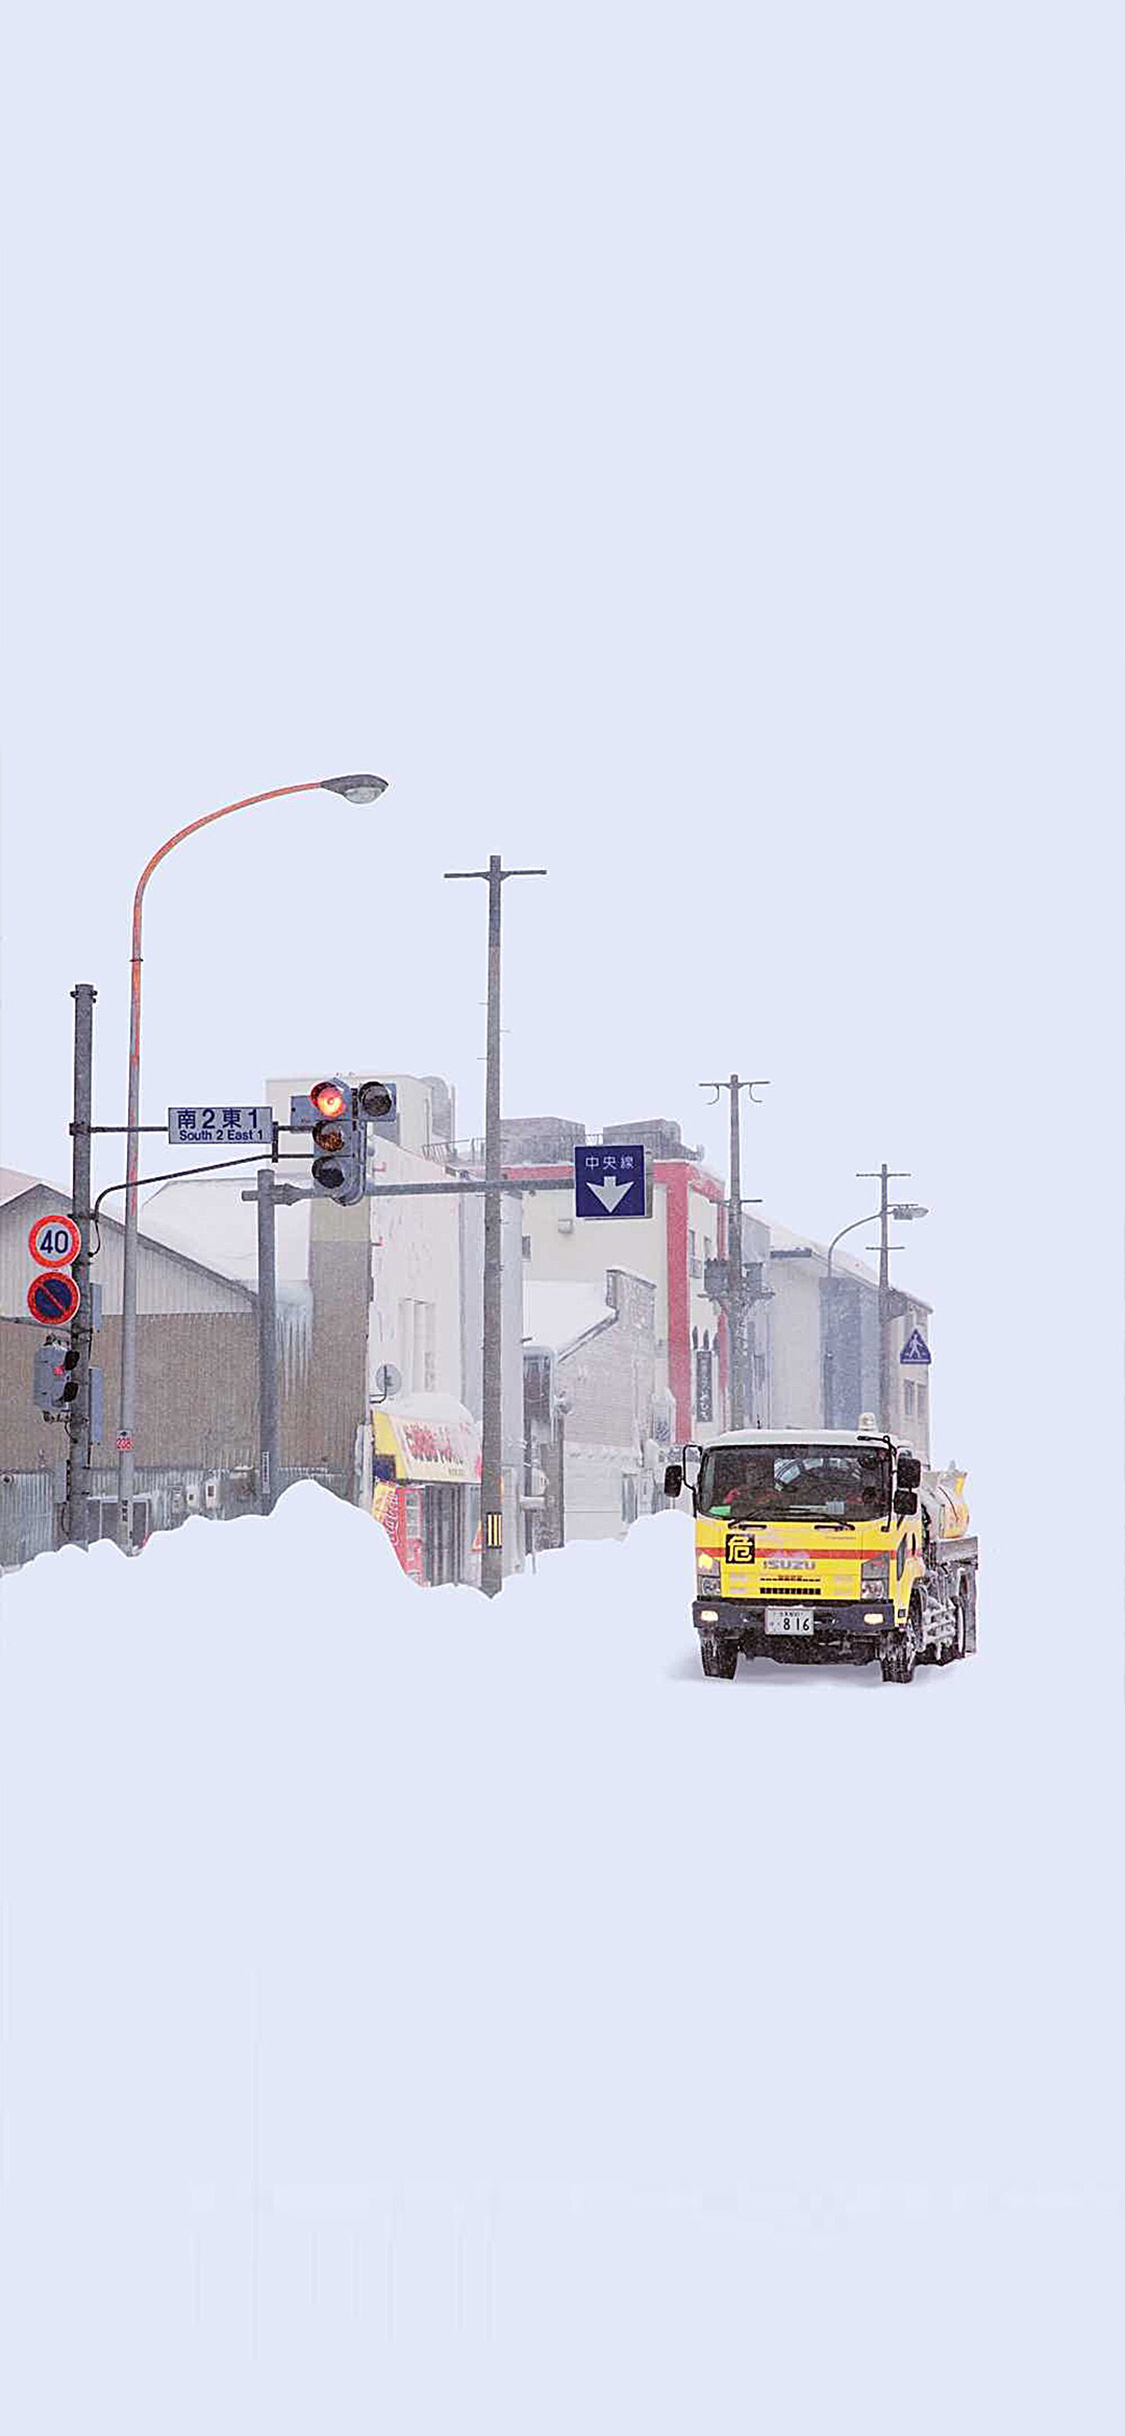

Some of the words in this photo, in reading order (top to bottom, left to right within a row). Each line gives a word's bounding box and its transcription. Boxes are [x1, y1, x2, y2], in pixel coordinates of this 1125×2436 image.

[179, 1129, 212, 1141] South
[216, 1130, 224, 1140] 2
[227, 1129, 253, 1140] East
[257, 1129, 263, 1140] 1
[585, 1155, 634, 1170] 中央線
[40, 1230, 69, 1254] 40
[727, 1535, 753, 1562] 危
[763, 1559, 816, 1570] ISUZU
